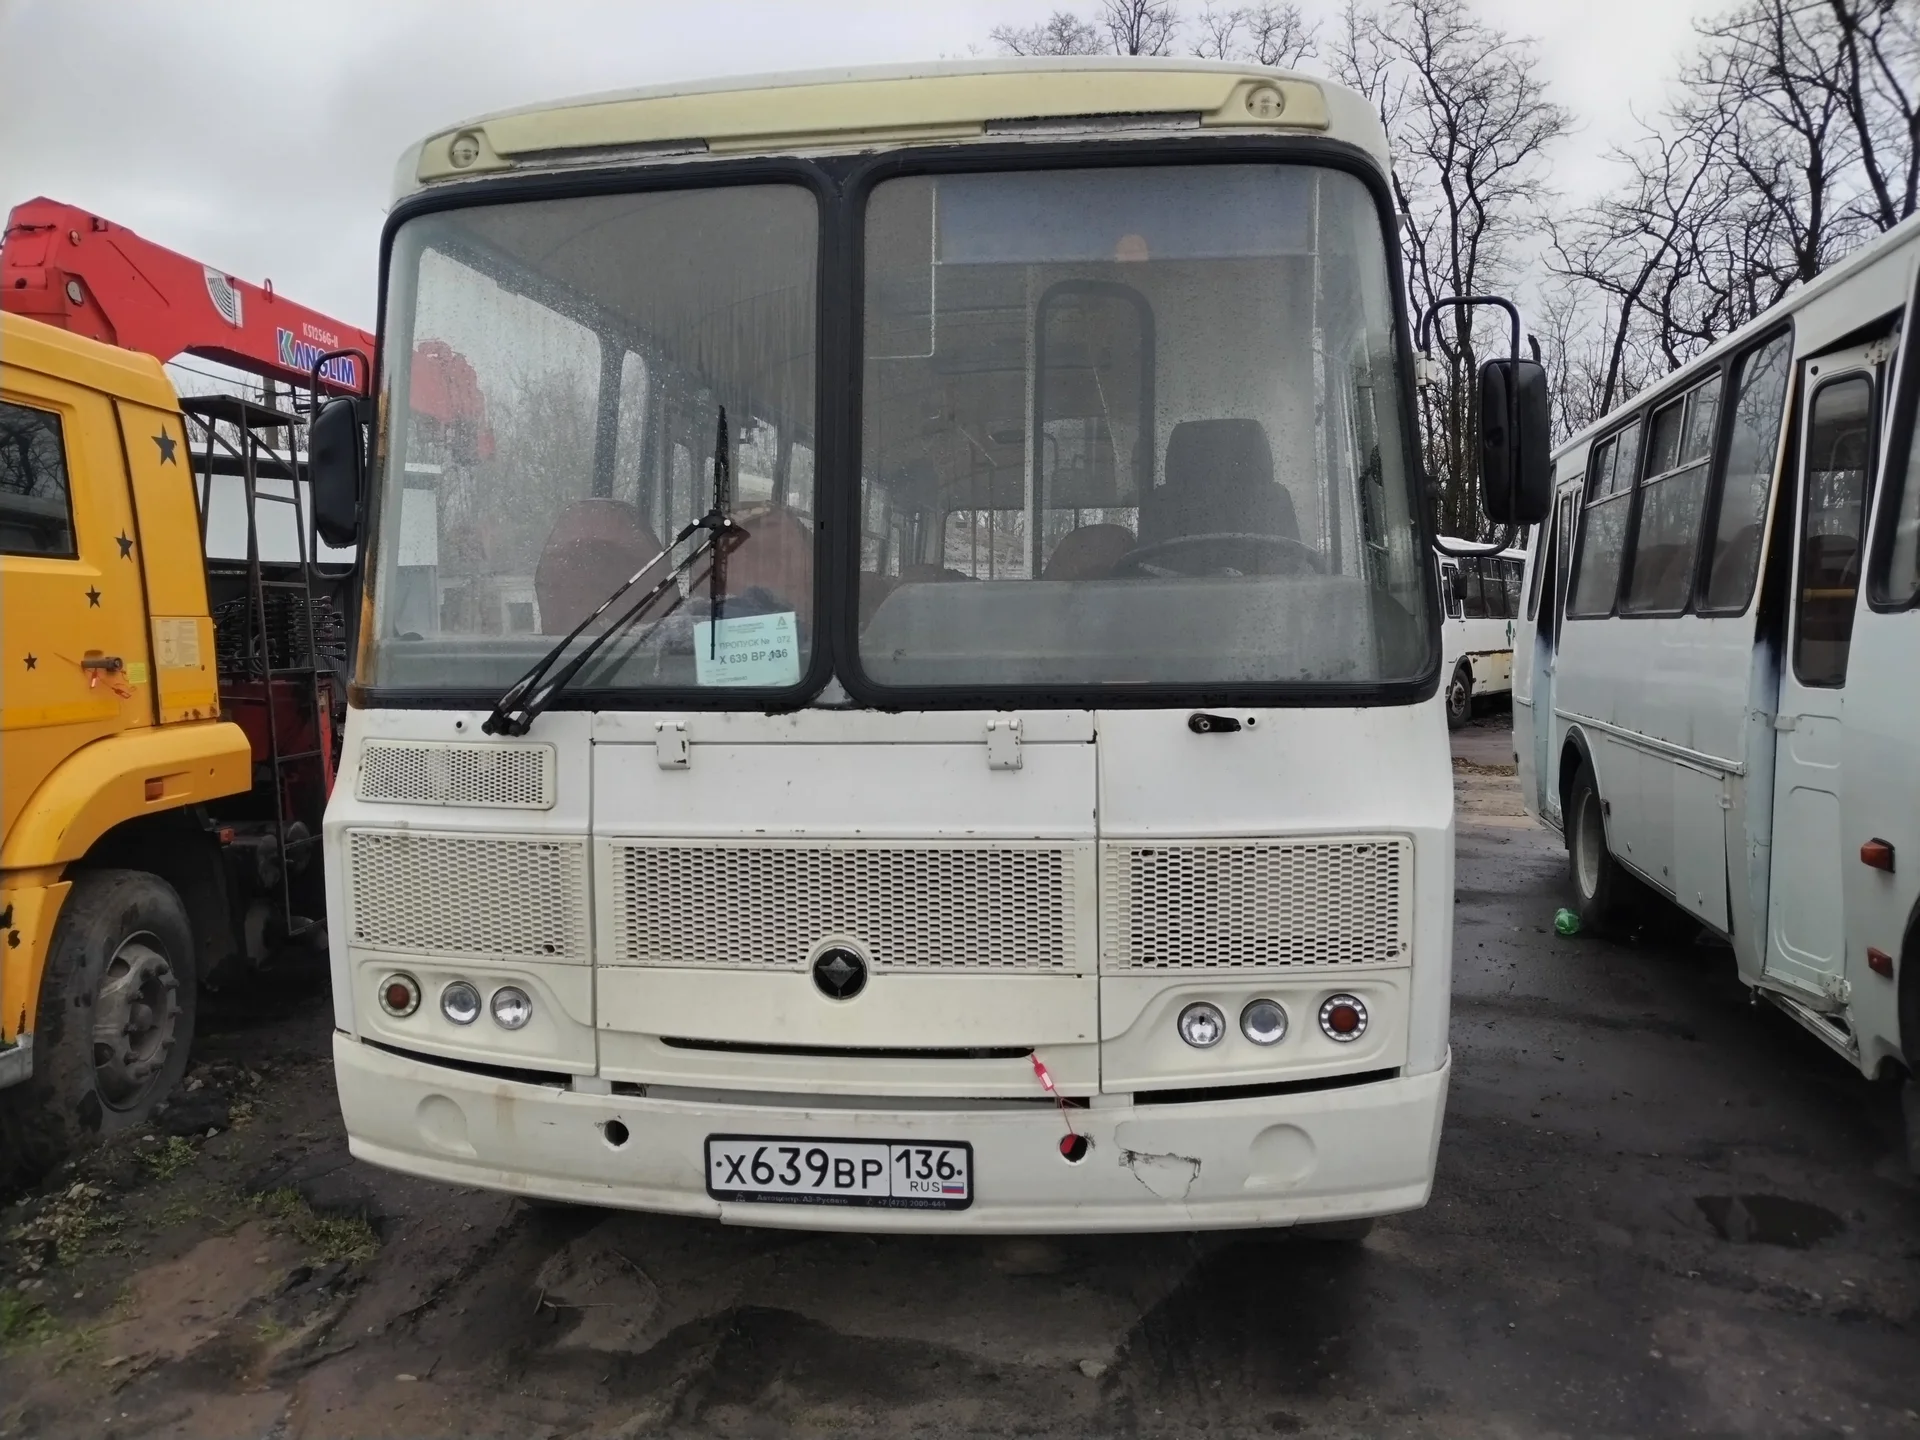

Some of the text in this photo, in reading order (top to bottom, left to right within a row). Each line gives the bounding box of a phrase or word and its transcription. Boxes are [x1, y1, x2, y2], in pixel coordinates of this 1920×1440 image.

[276, 326, 357, 388] KANGLIM
[719, 638, 759, 649] ПРОПУСК
[729, 653, 748, 664] 639
[895, 1148, 955, 1181] 136
[909, 1181, 940, 1193] RUS
